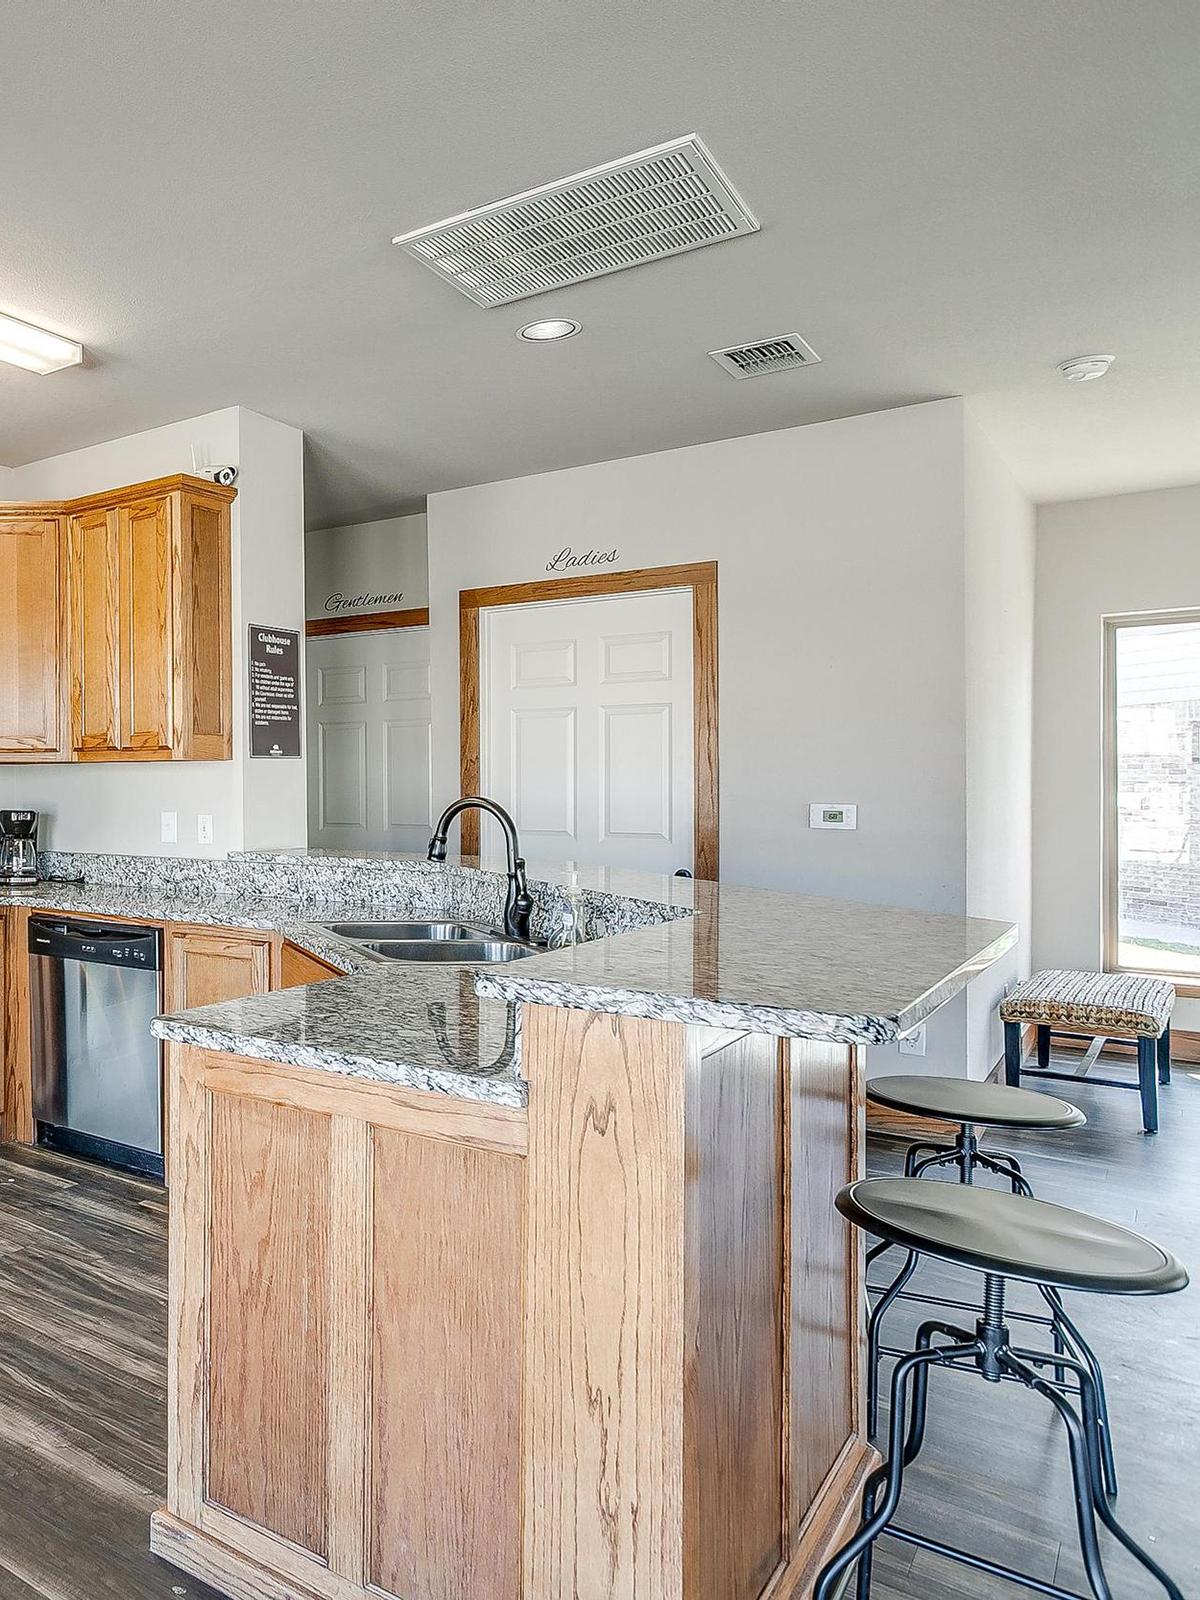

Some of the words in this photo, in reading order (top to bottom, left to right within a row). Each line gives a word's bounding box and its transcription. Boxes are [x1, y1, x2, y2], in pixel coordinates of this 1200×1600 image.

[545, 546, 620, 572] Ladies
[324, 590, 404, 612] Gentlemen
[258, 632, 290, 646] Clubhouse
[266, 644, 284, 655] Rules
